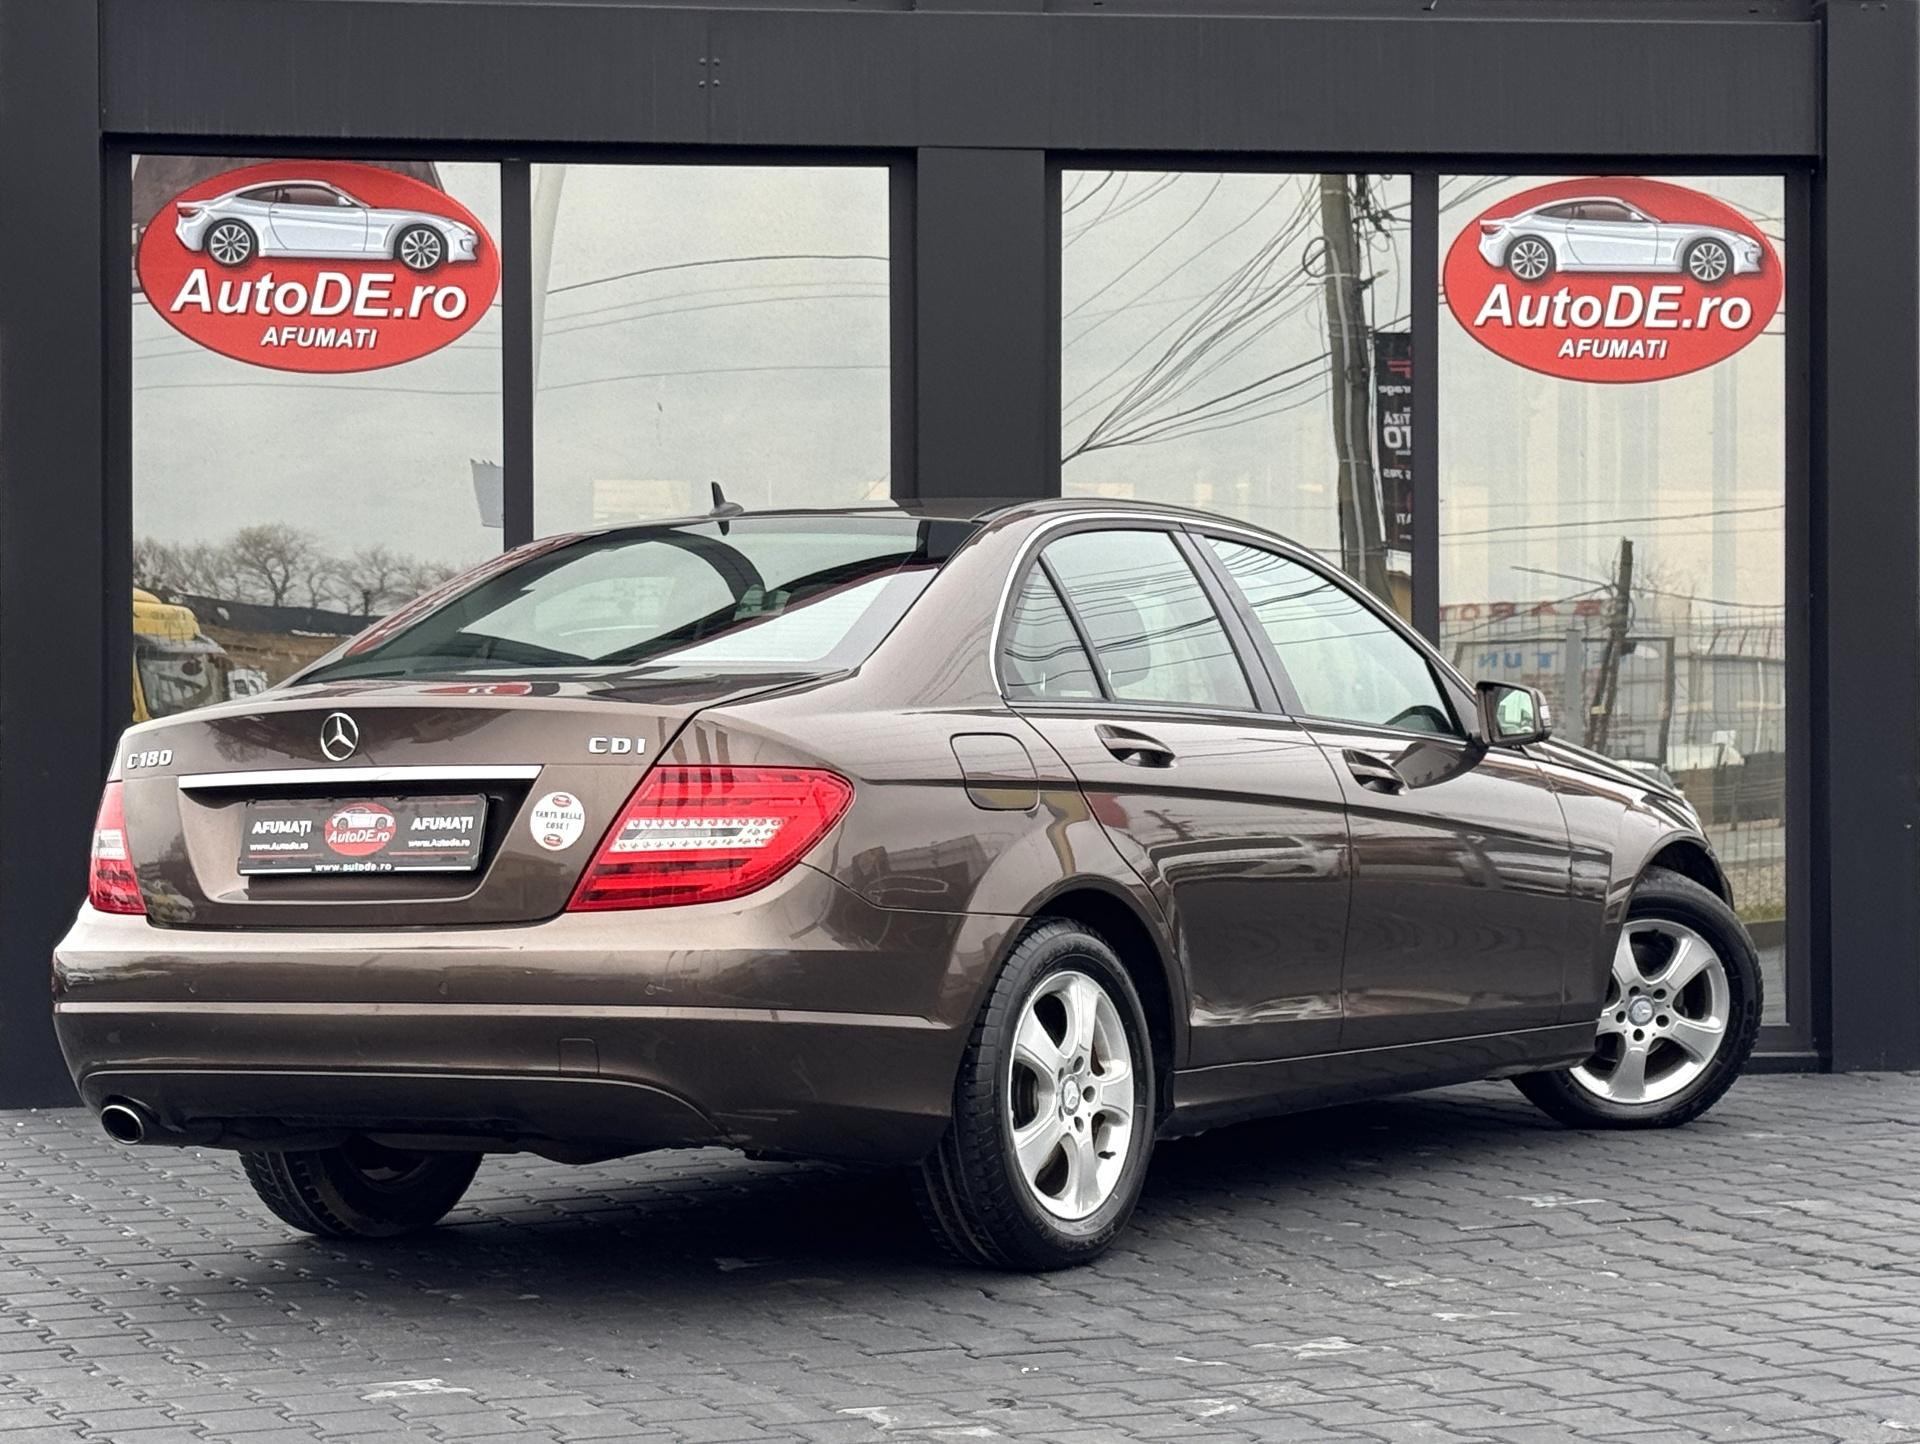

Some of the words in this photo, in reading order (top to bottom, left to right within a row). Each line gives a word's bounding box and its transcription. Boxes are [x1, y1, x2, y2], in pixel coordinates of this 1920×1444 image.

[170, 268, 467, 319] AutoDE.ro
[1473, 283, 1752, 329] AutoDE.ro
[260, 326, 378, 348] AFUMATI
[1558, 338, 1668, 359] AFUMATI
[588, 737, 646, 755] CDI
[328, 829, 390, 844] AutoDE.ro
